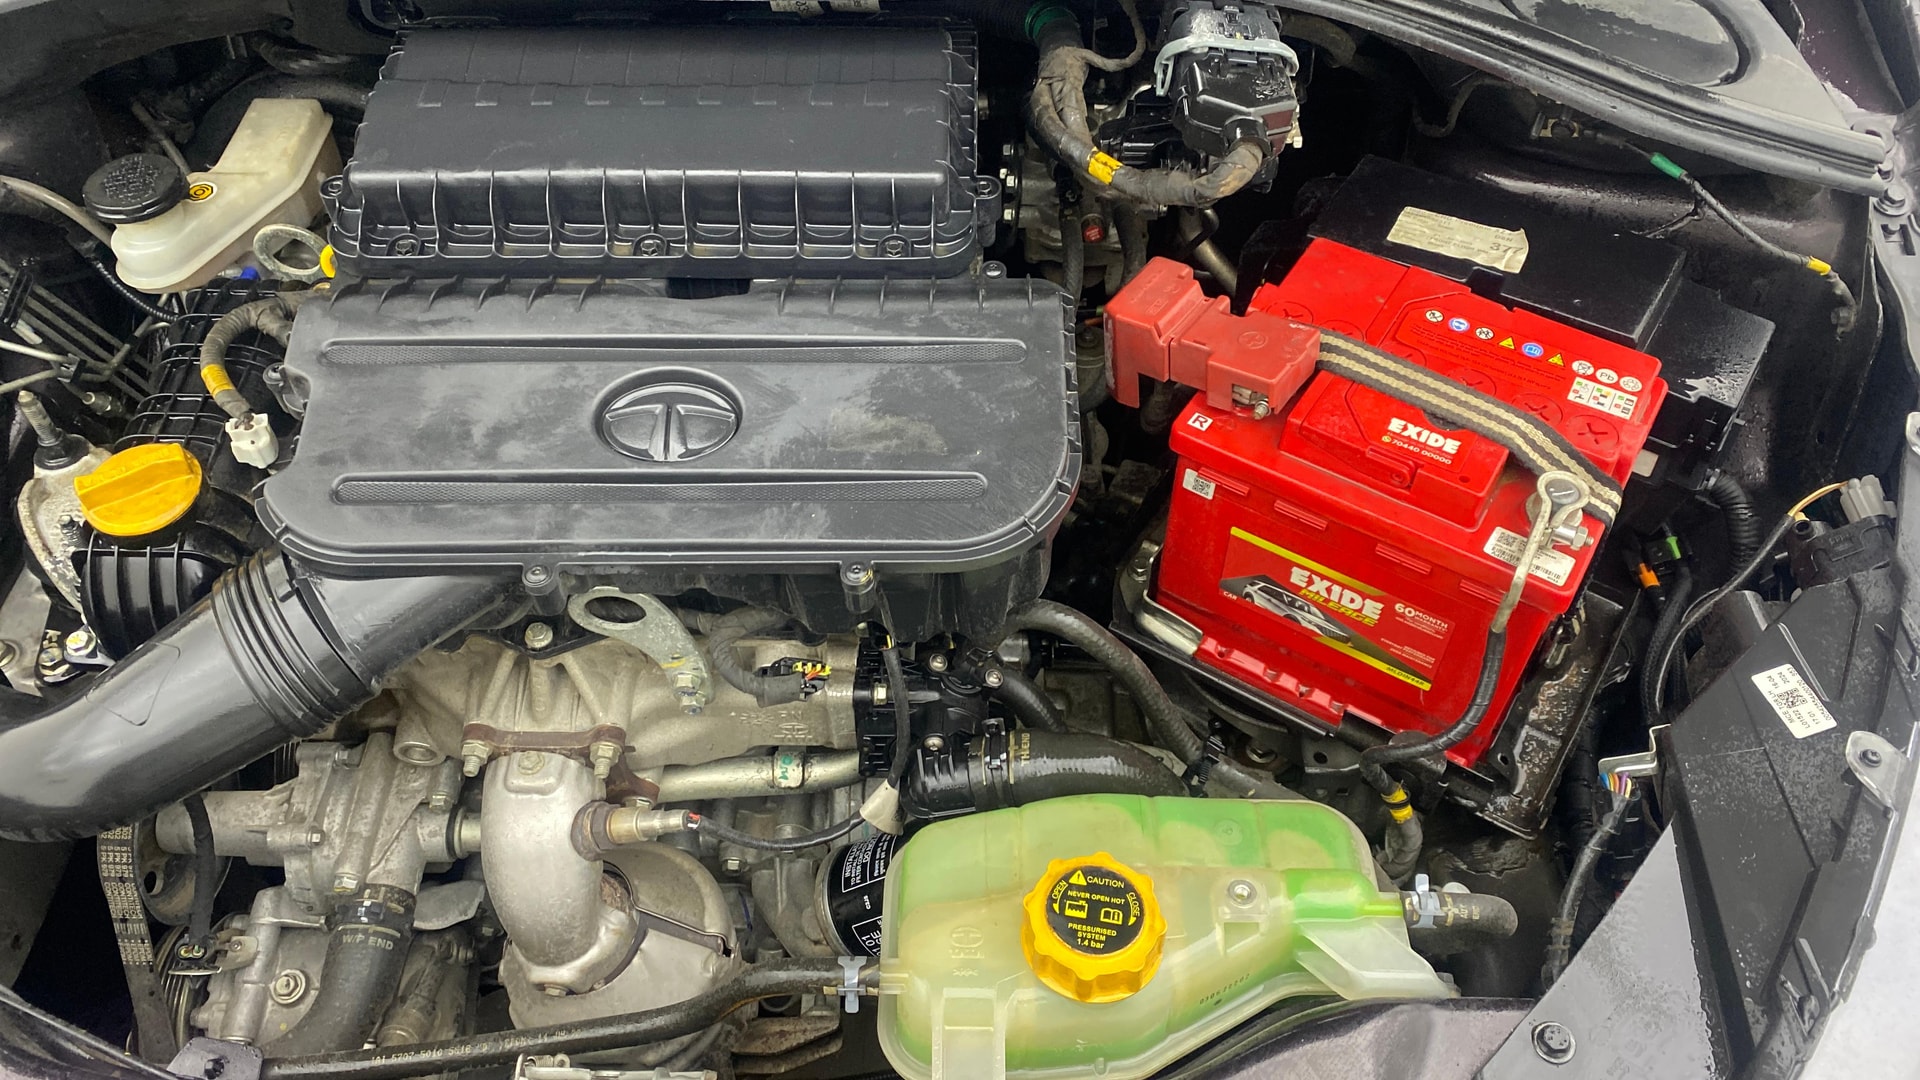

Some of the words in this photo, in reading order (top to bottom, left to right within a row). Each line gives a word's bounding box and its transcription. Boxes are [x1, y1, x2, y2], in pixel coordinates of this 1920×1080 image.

[1490, 242, 1524, 254] 377
[1600, 372, 1615, 381] Pb
[1192, 415, 1208, 428] R
[1388, 417, 1462, 454] EXIDE
[1391, 439, 1420, 452] 70440
[1421, 450, 1452, 464] 00000
[1223, 591, 1237, 600] CAR
[1290, 566, 1384, 620] EXIDE
[1299, 589, 1378, 627] MILEAGE
[1394, 603, 1416, 617] 60
[1415, 611, 1448, 629] MONTH
[1052, 880, 1067, 899] OPEN
[1087, 876, 1125, 889] CAUTION
[1067, 890, 1090, 899] NEVER
[1091, 894, 1110, 903] OPEN
[1110, 897, 1126, 905] HOT
[1128, 892, 1140, 917] CLOSE
[1067, 922, 1117, 936] PRESSURISED
[1077, 931, 1106, 941] SYSTEM
[368, 936, 393, 950] END
[1077, 938, 1089, 946] 1.4
[1090, 940, 1105, 949] bar
